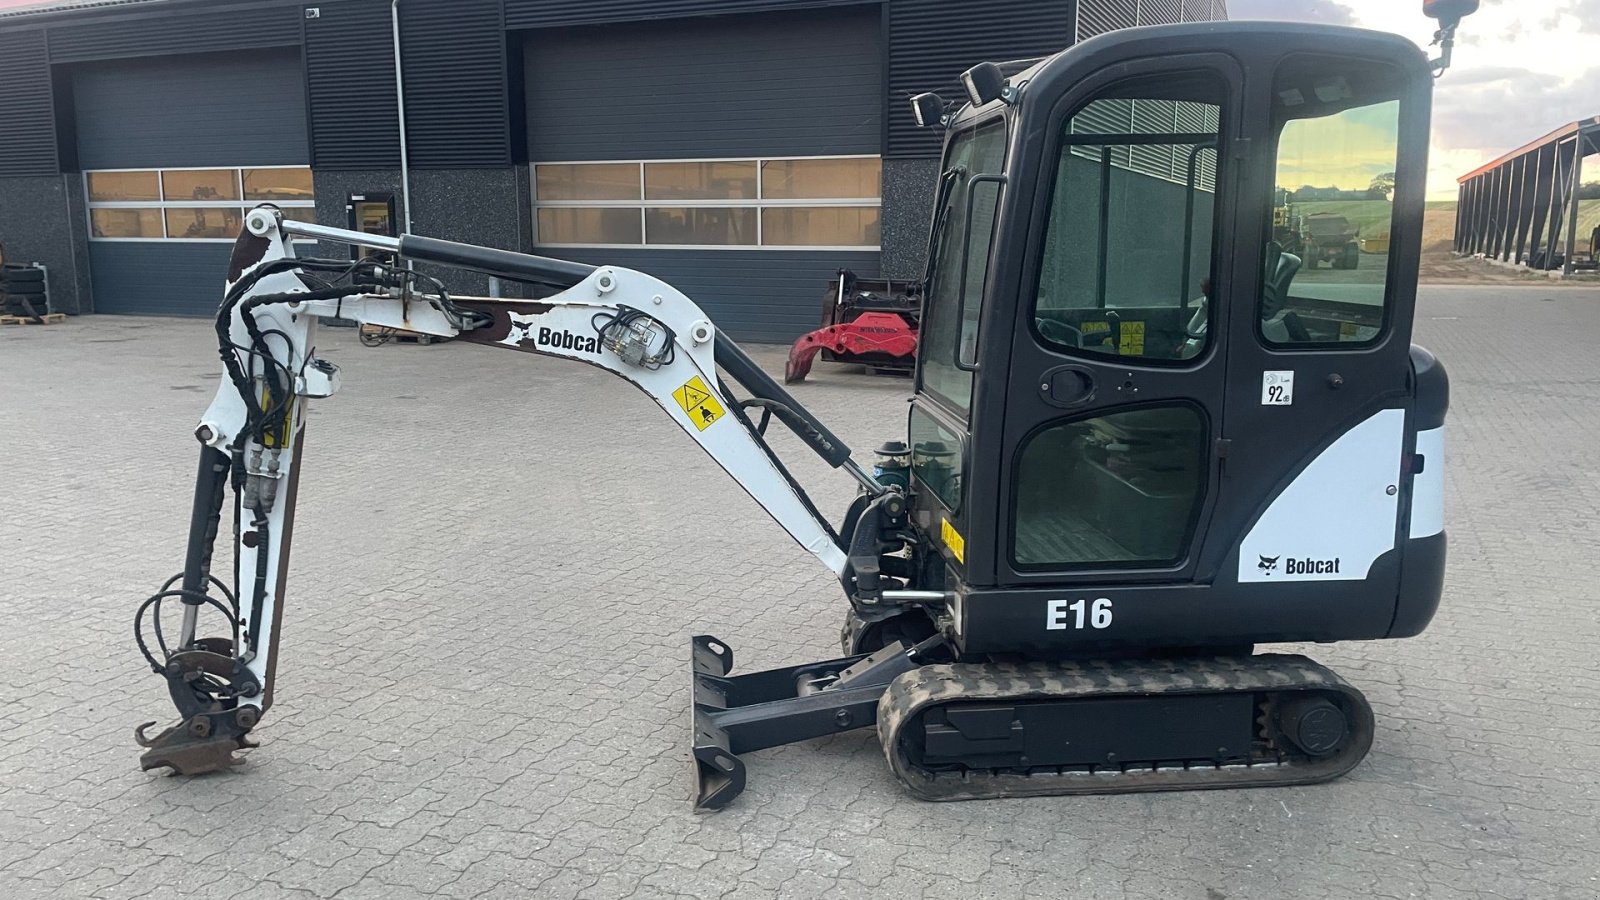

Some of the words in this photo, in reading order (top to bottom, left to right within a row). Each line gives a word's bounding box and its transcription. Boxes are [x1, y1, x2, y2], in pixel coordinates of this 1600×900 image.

[1269, 386, 1283, 402] 92
[1286, 558, 1340, 574] Bobcat
[1046, 598, 1113, 630] E16
